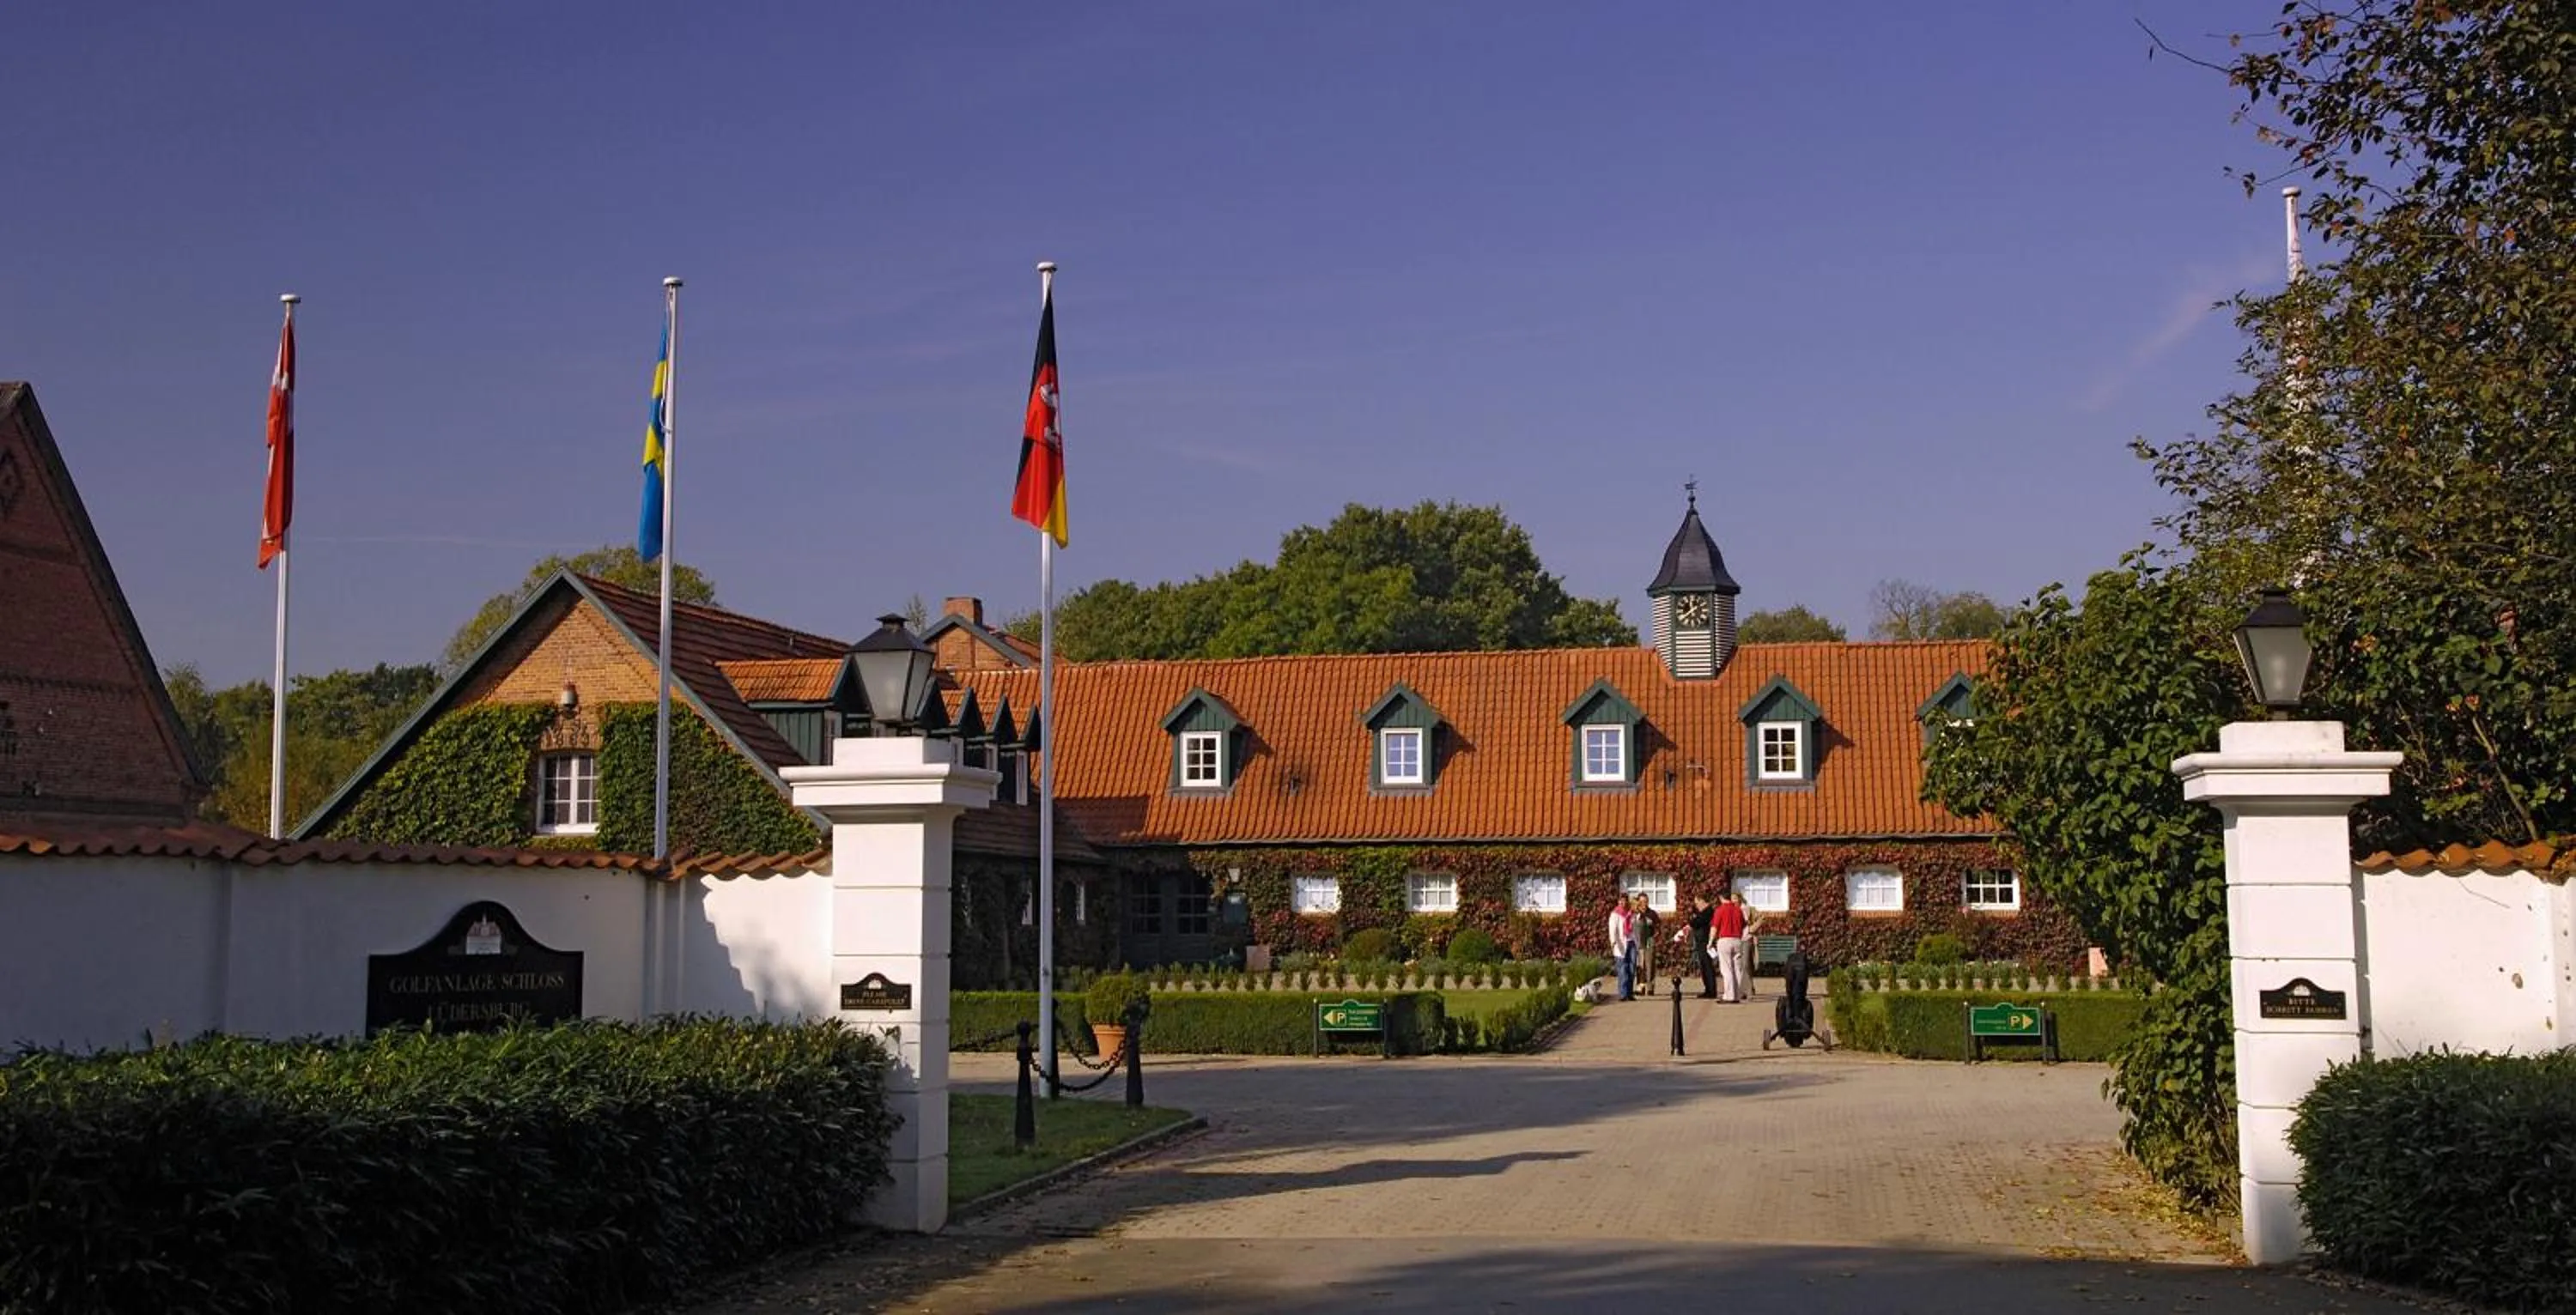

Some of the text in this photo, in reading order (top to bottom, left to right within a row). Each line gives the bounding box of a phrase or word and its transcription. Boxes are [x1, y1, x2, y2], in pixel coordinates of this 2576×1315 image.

[389, 972, 565, 994] GOLFANLAGE SCHLOSS
[1337, 1012, 1346, 1023] P
[2010, 1015, 2020, 1027] P
